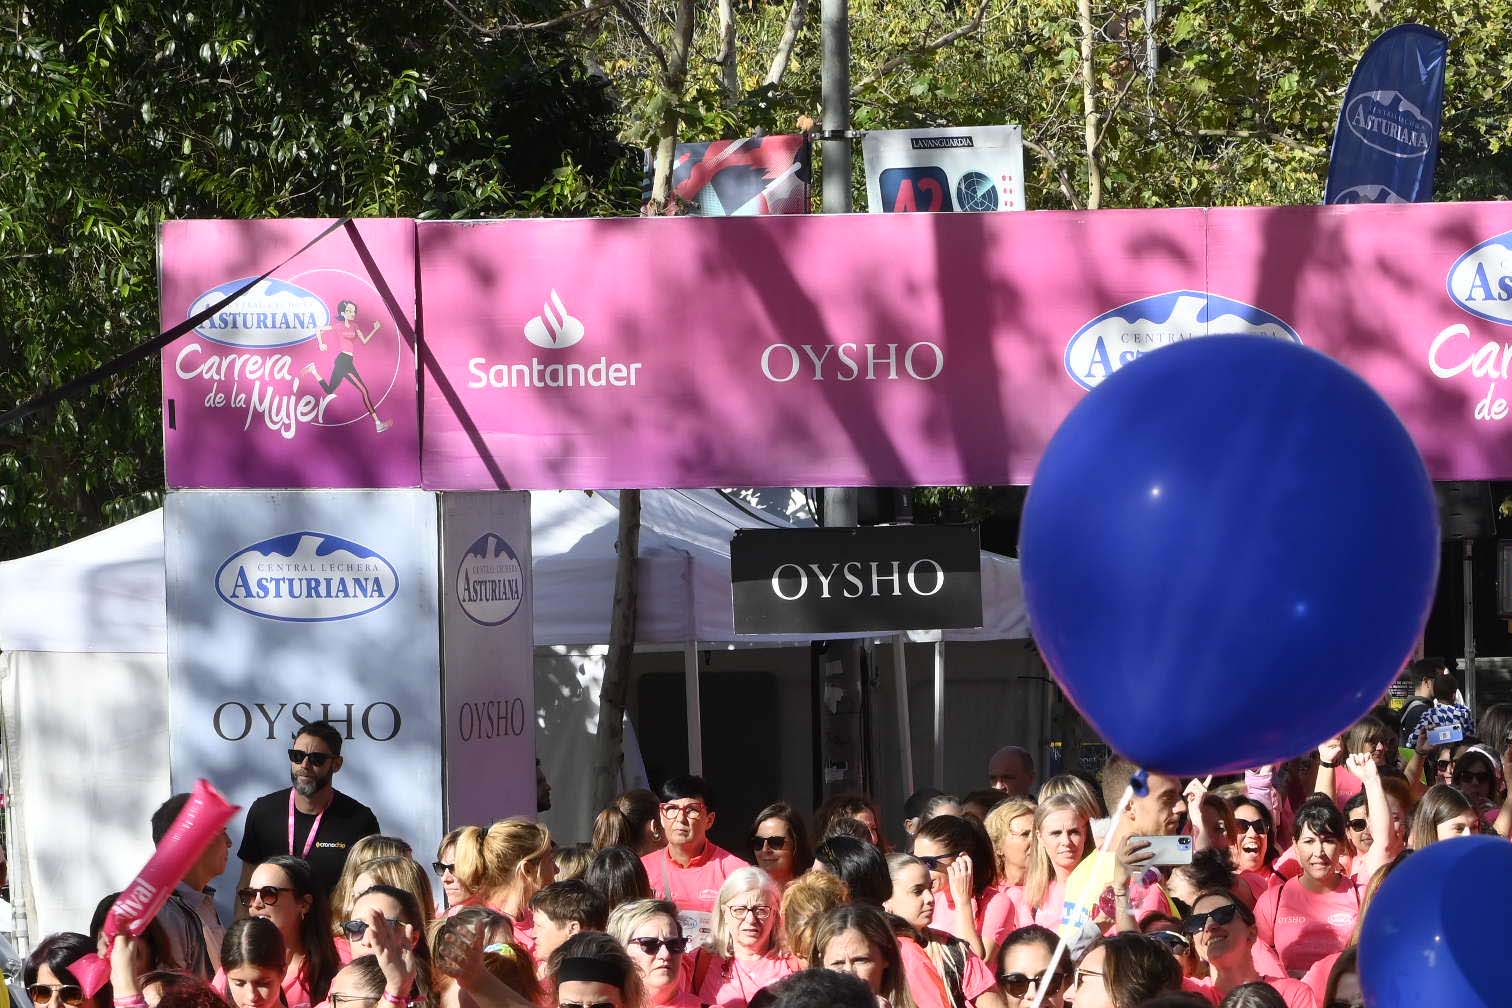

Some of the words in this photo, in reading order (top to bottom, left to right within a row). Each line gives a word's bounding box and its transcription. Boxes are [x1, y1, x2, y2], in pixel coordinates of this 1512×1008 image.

[1352, 104, 1428, 148] ASTURIANA
[200, 303, 318, 331] ASTURIANA
[175, 343, 293, 381] Carrera
[468, 356, 643, 389] Santander
[760, 341, 945, 383] OYSHO
[204, 382, 226, 408] de
[231, 382, 247, 408] la
[244, 375, 338, 439] Mujer
[1474, 382, 1508, 420] de
[230, 565, 386, 600] ASTURIANA
[257, 563, 317, 573] CENTRAL
[320, 563, 380, 573] LECHERA
[462, 566, 520, 604] ASTURIANA
[771, 559, 945, 600] OYSHO
[213, 702, 402, 742] OYSHO
[458, 698, 525, 742] OYSHO
